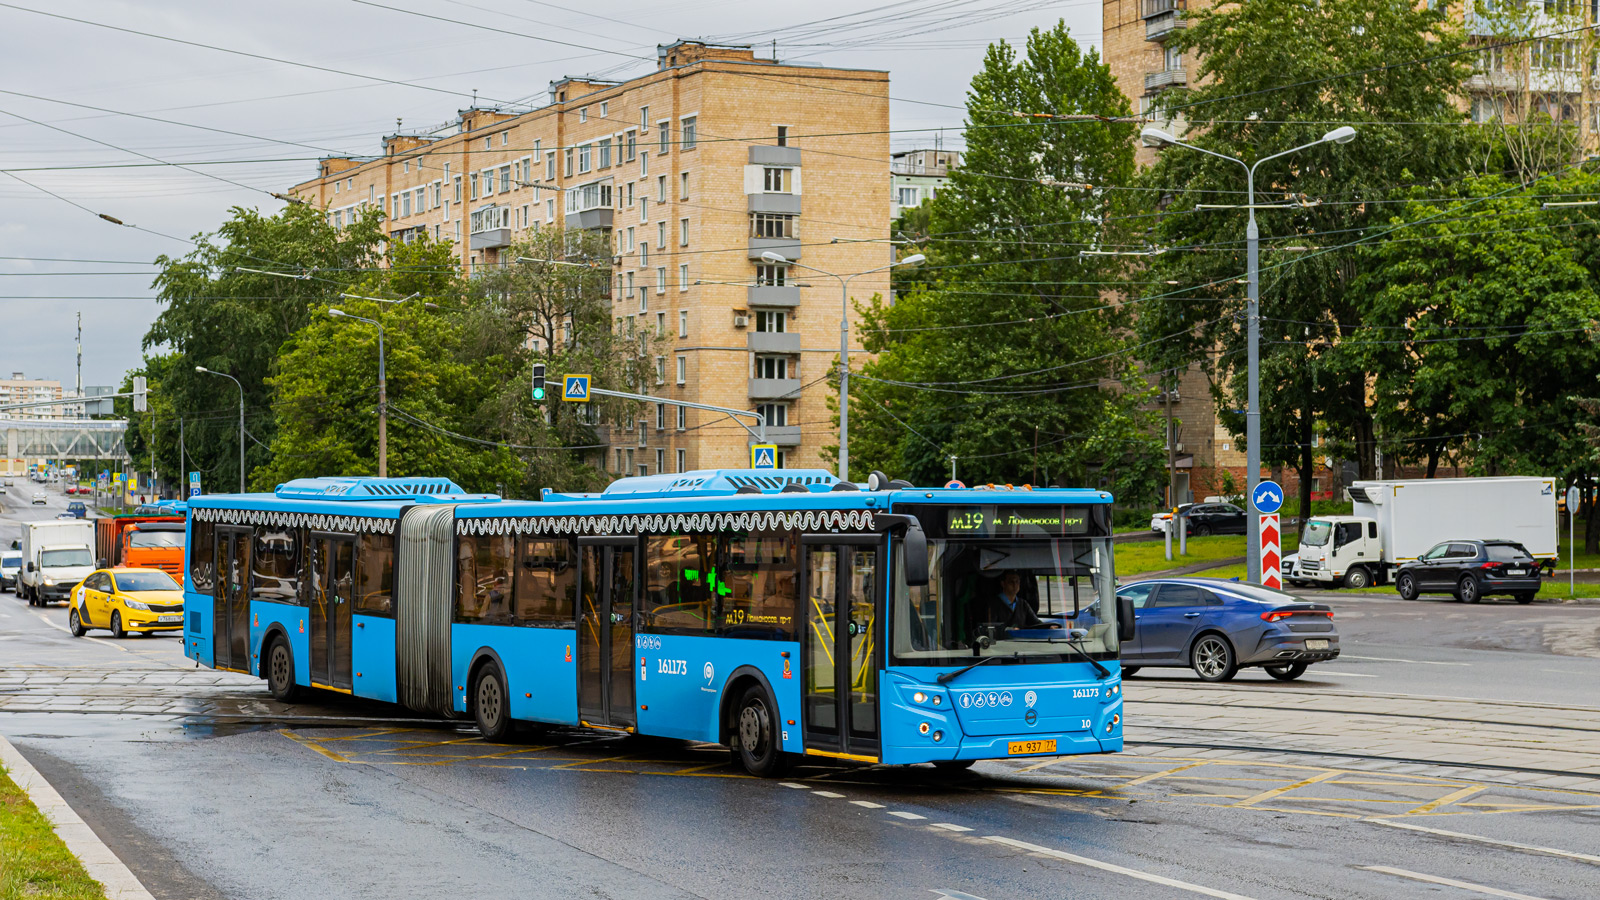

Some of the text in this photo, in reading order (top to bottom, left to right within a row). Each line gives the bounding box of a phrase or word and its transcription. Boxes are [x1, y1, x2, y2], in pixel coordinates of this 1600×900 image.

[1064, 518, 1083, 526] пр-т
[658, 658, 687, 675] 161173
[1073, 688, 1099, 698] 161173
[1081, 719, 1091, 728] 10
[1026, 742, 1042, 752] 937
